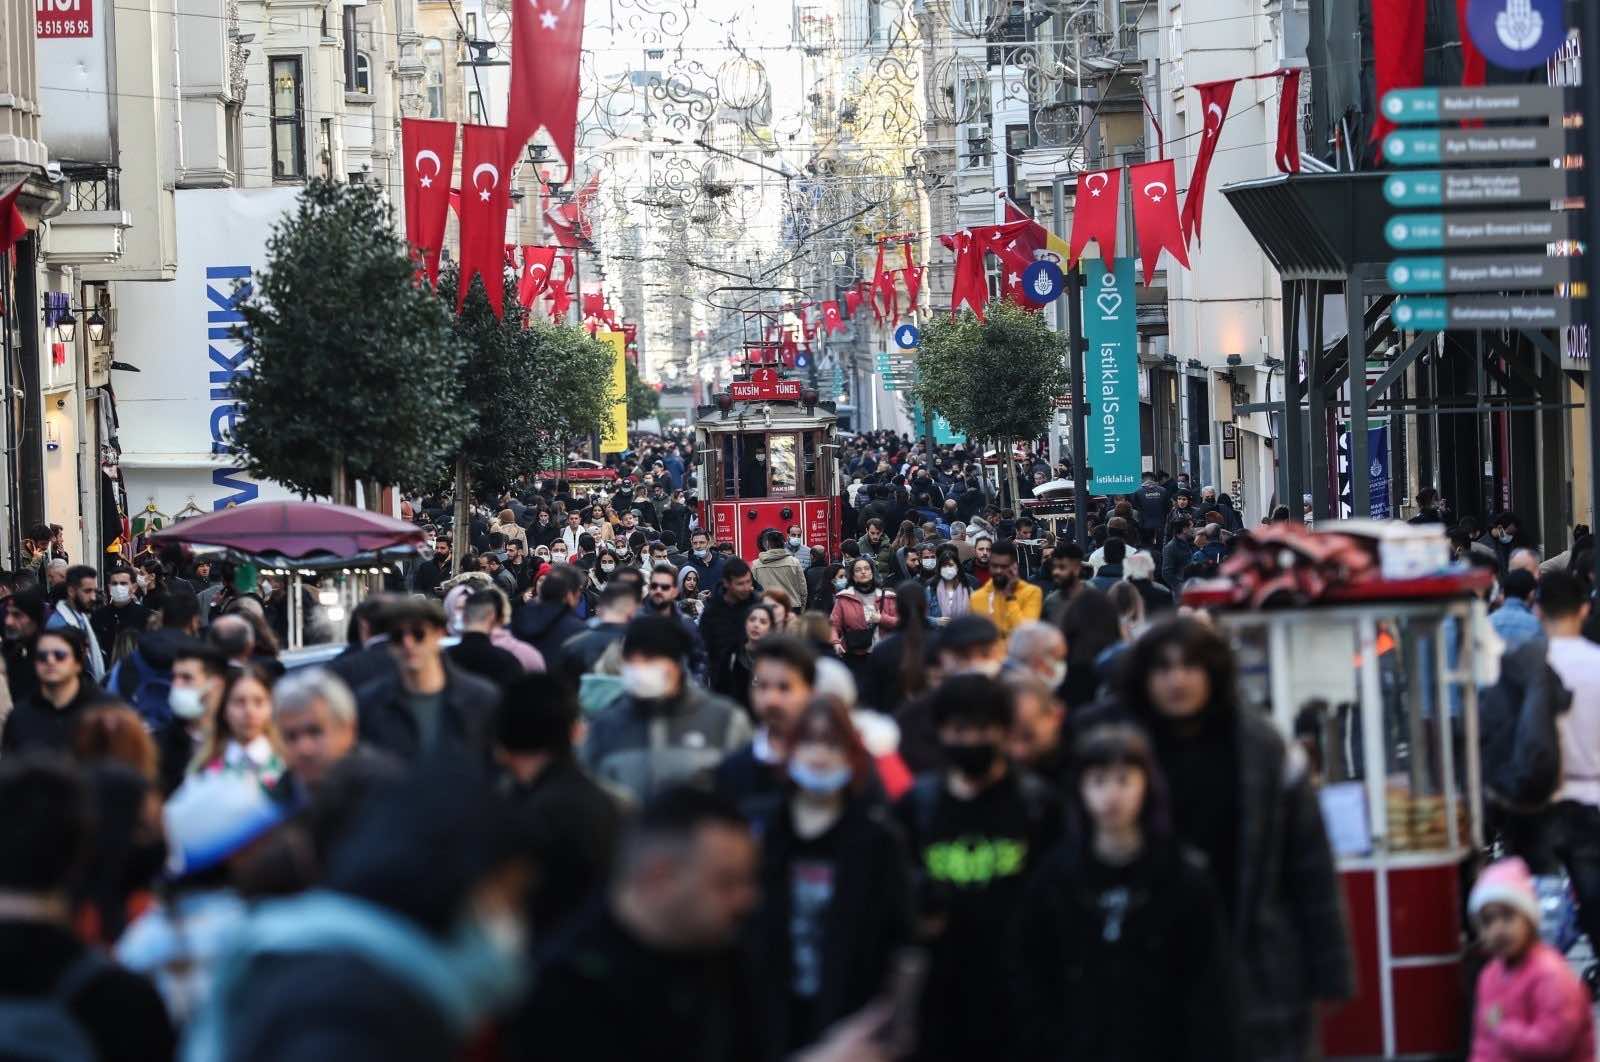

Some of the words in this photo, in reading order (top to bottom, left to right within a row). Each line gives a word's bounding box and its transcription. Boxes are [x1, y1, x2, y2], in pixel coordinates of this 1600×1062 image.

[45, 21, 62, 34] 515
[64, 21, 75, 34] 95
[77, 21, 89, 34] 95
[762, 369, 768, 381] 2
[734, 384, 759, 396] TAKSİM
[775, 382, 798, 394] TÜNEL
